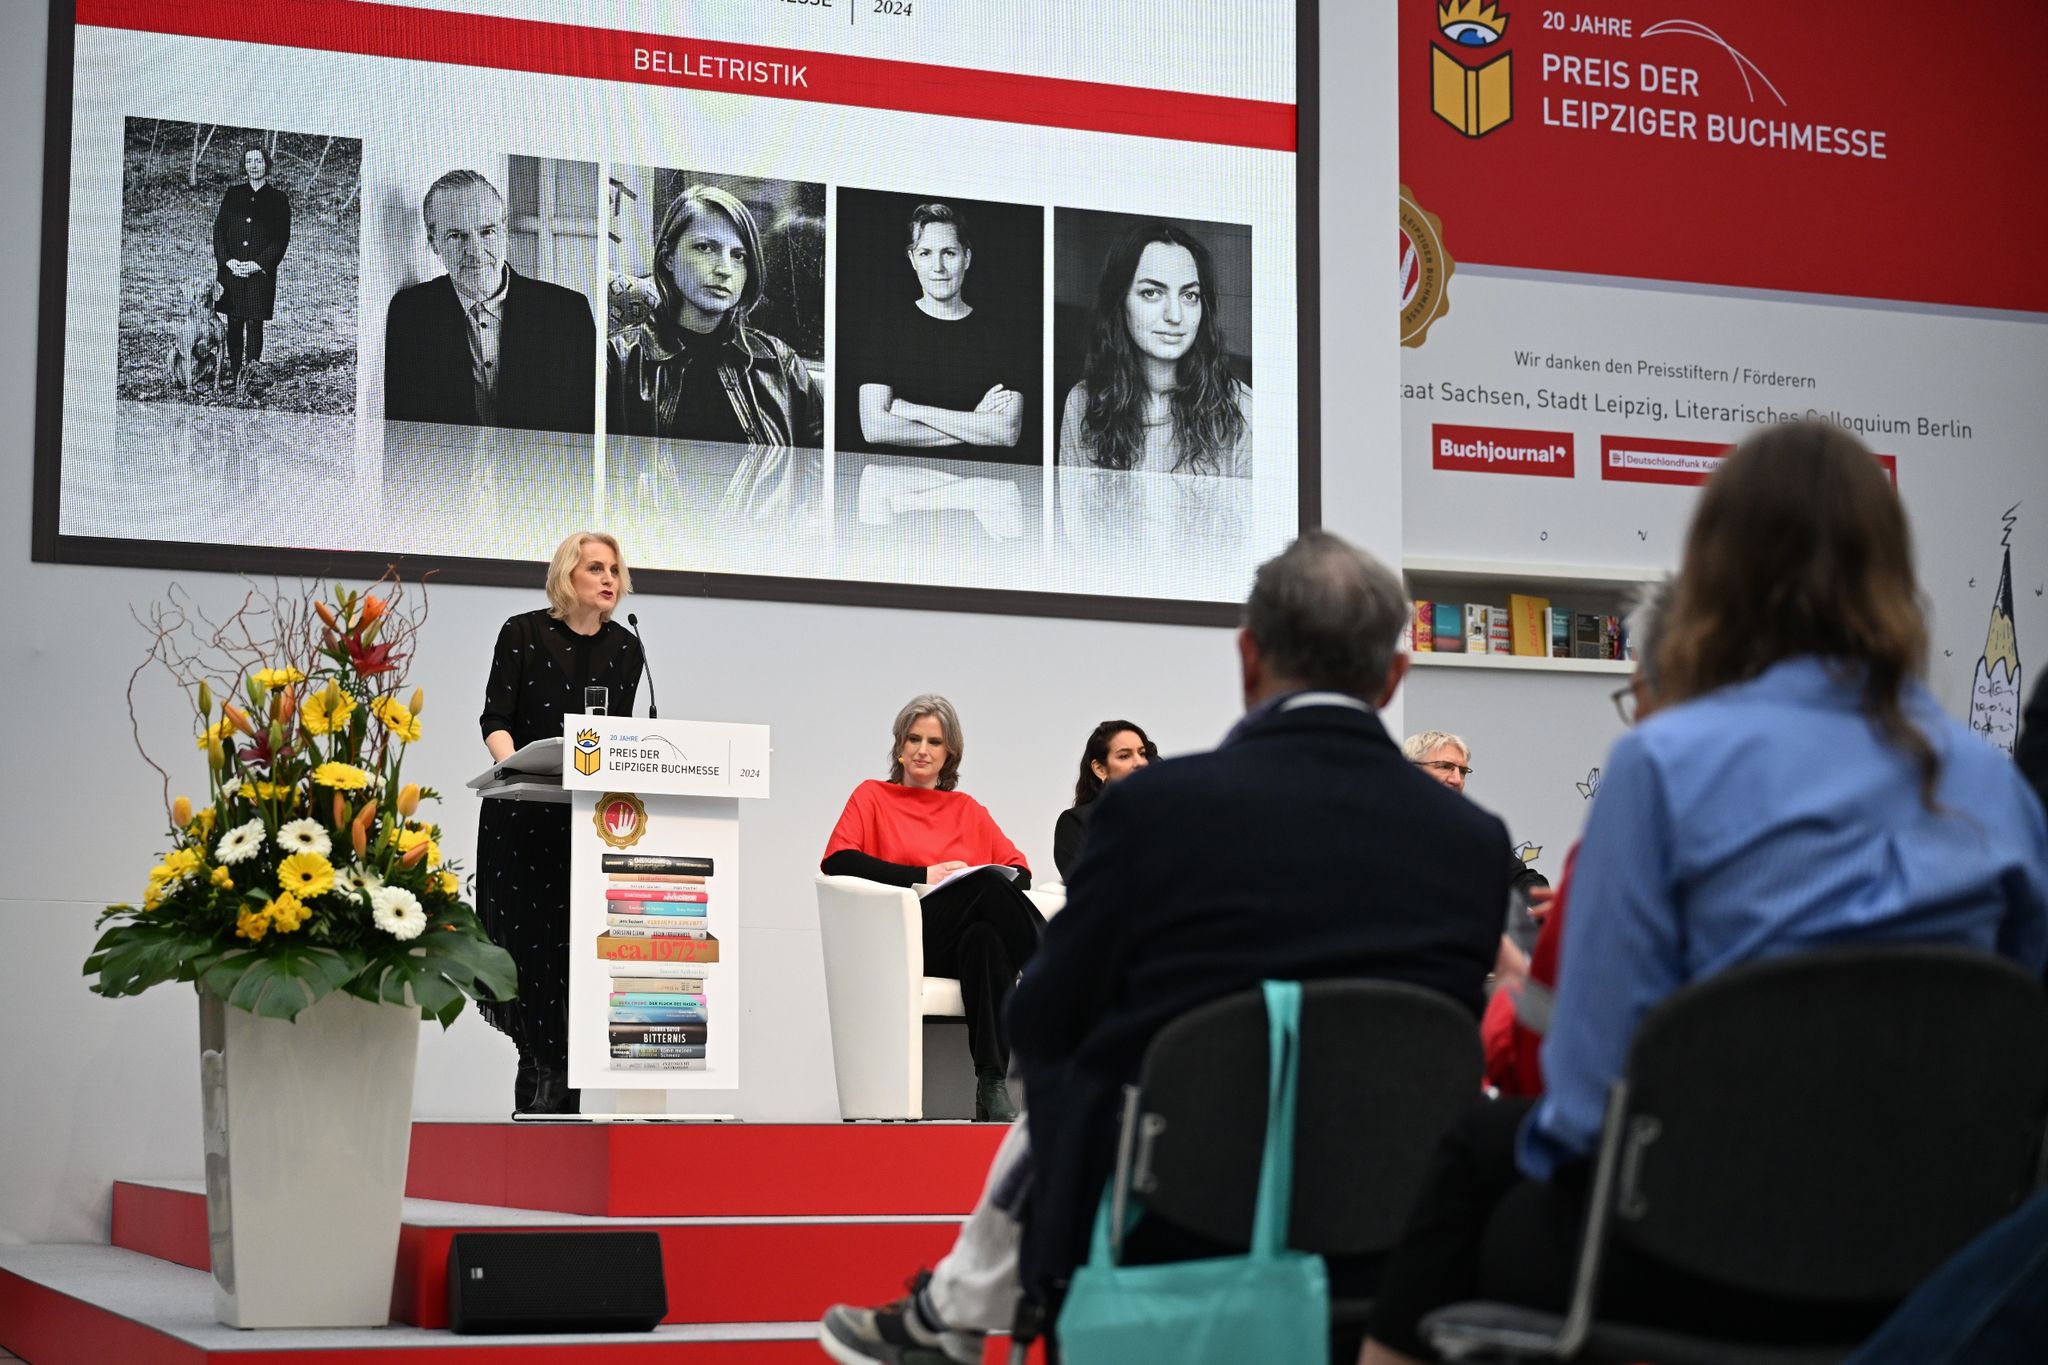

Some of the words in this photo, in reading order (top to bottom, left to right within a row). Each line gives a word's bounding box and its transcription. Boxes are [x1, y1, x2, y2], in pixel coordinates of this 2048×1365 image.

[873, 0, 912, 16] 2024
[1542, 11, 1565, 31] 20
[1569, 14, 1632, 38] JAHRE
[634, 48, 809, 88] BELLETRISTIK
[1543, 53, 1630, 90] PREIS
[1640, 63, 1700, 97] DER
[1543, 96, 1697, 140] LEIPZIGER
[1707, 113, 1887, 159] BUCHMESSE
[1402, 213, 1434, 264] LEIPZIGER
[1405, 267, 1434, 324] BUCHMESSE
[1514, 351, 1541, 367] Wir
[1545, 354, 1600, 372] danken
[1605, 358, 1632, 374] den
[1637, 360, 1728, 383] Preisstiftern
[1744, 368, 1816, 389] Förderern
[1400, 383, 1434, 400] aat
[1441, 382, 1530, 409] Sachsen,
[1537, 389, 1587, 411] Stadt
[1594, 393, 1669, 421] Leipzig,
[1676, 399, 1800, 425] Literarisches
[1918, 417, 1973, 439] Berlin
[1440, 438, 1555, 463] Buchjournal
[1627, 455, 1700, 469] Deutschlandfunk
[609, 748, 638, 758] PREIS
[640, 749, 660, 759] DER
[609, 762, 659, 773] LEIPZIGER
[661, 764, 720, 776] BUCHMESSE
[740, 768, 760, 778] 2024
[643, 1033, 686, 1044] BITTERNIS
